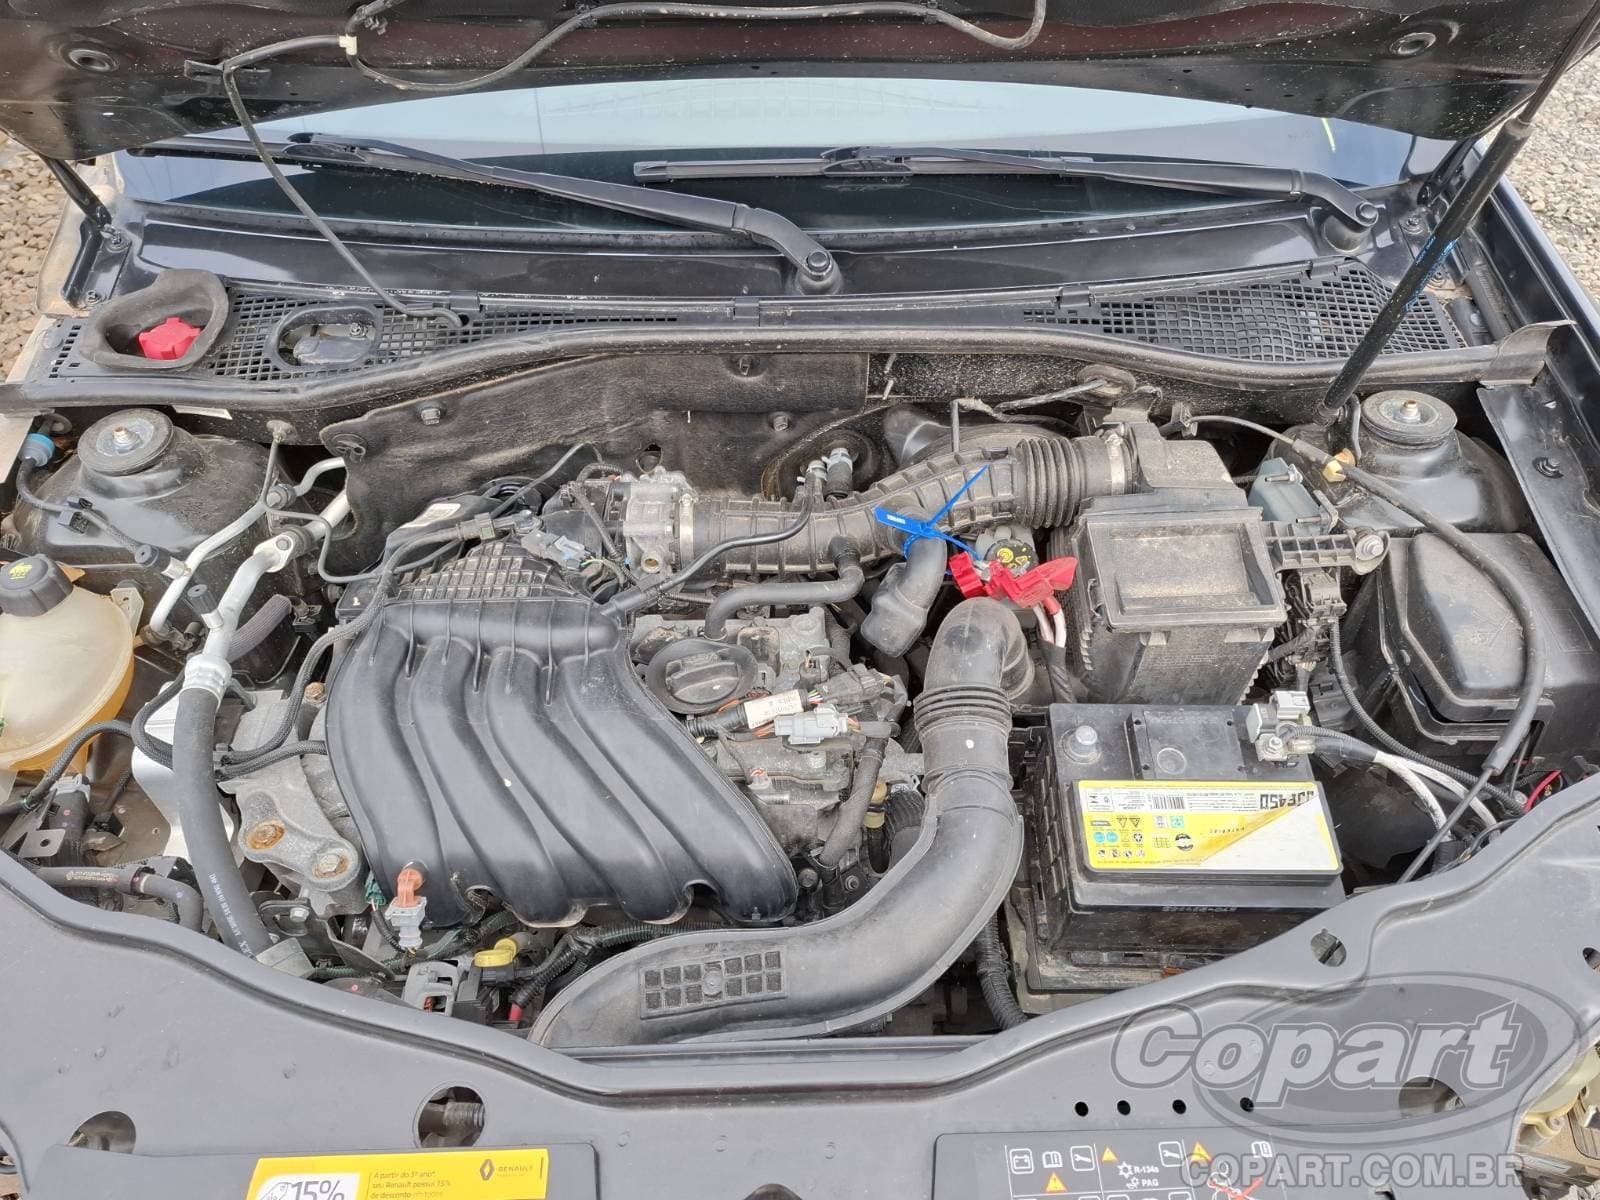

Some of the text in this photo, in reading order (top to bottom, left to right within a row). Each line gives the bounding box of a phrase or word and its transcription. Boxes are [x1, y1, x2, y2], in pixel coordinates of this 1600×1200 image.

[498, 1164, 534, 1173] RENAULT
[1134, 1165, 1159, 1174] R-134a
[385, 1181, 411, 1189] Renault
[1141, 1178, 1159, 1187] PAG
[291, 1178, 345, 1200] 15%
[380, 1191, 412, 1200] desconto
